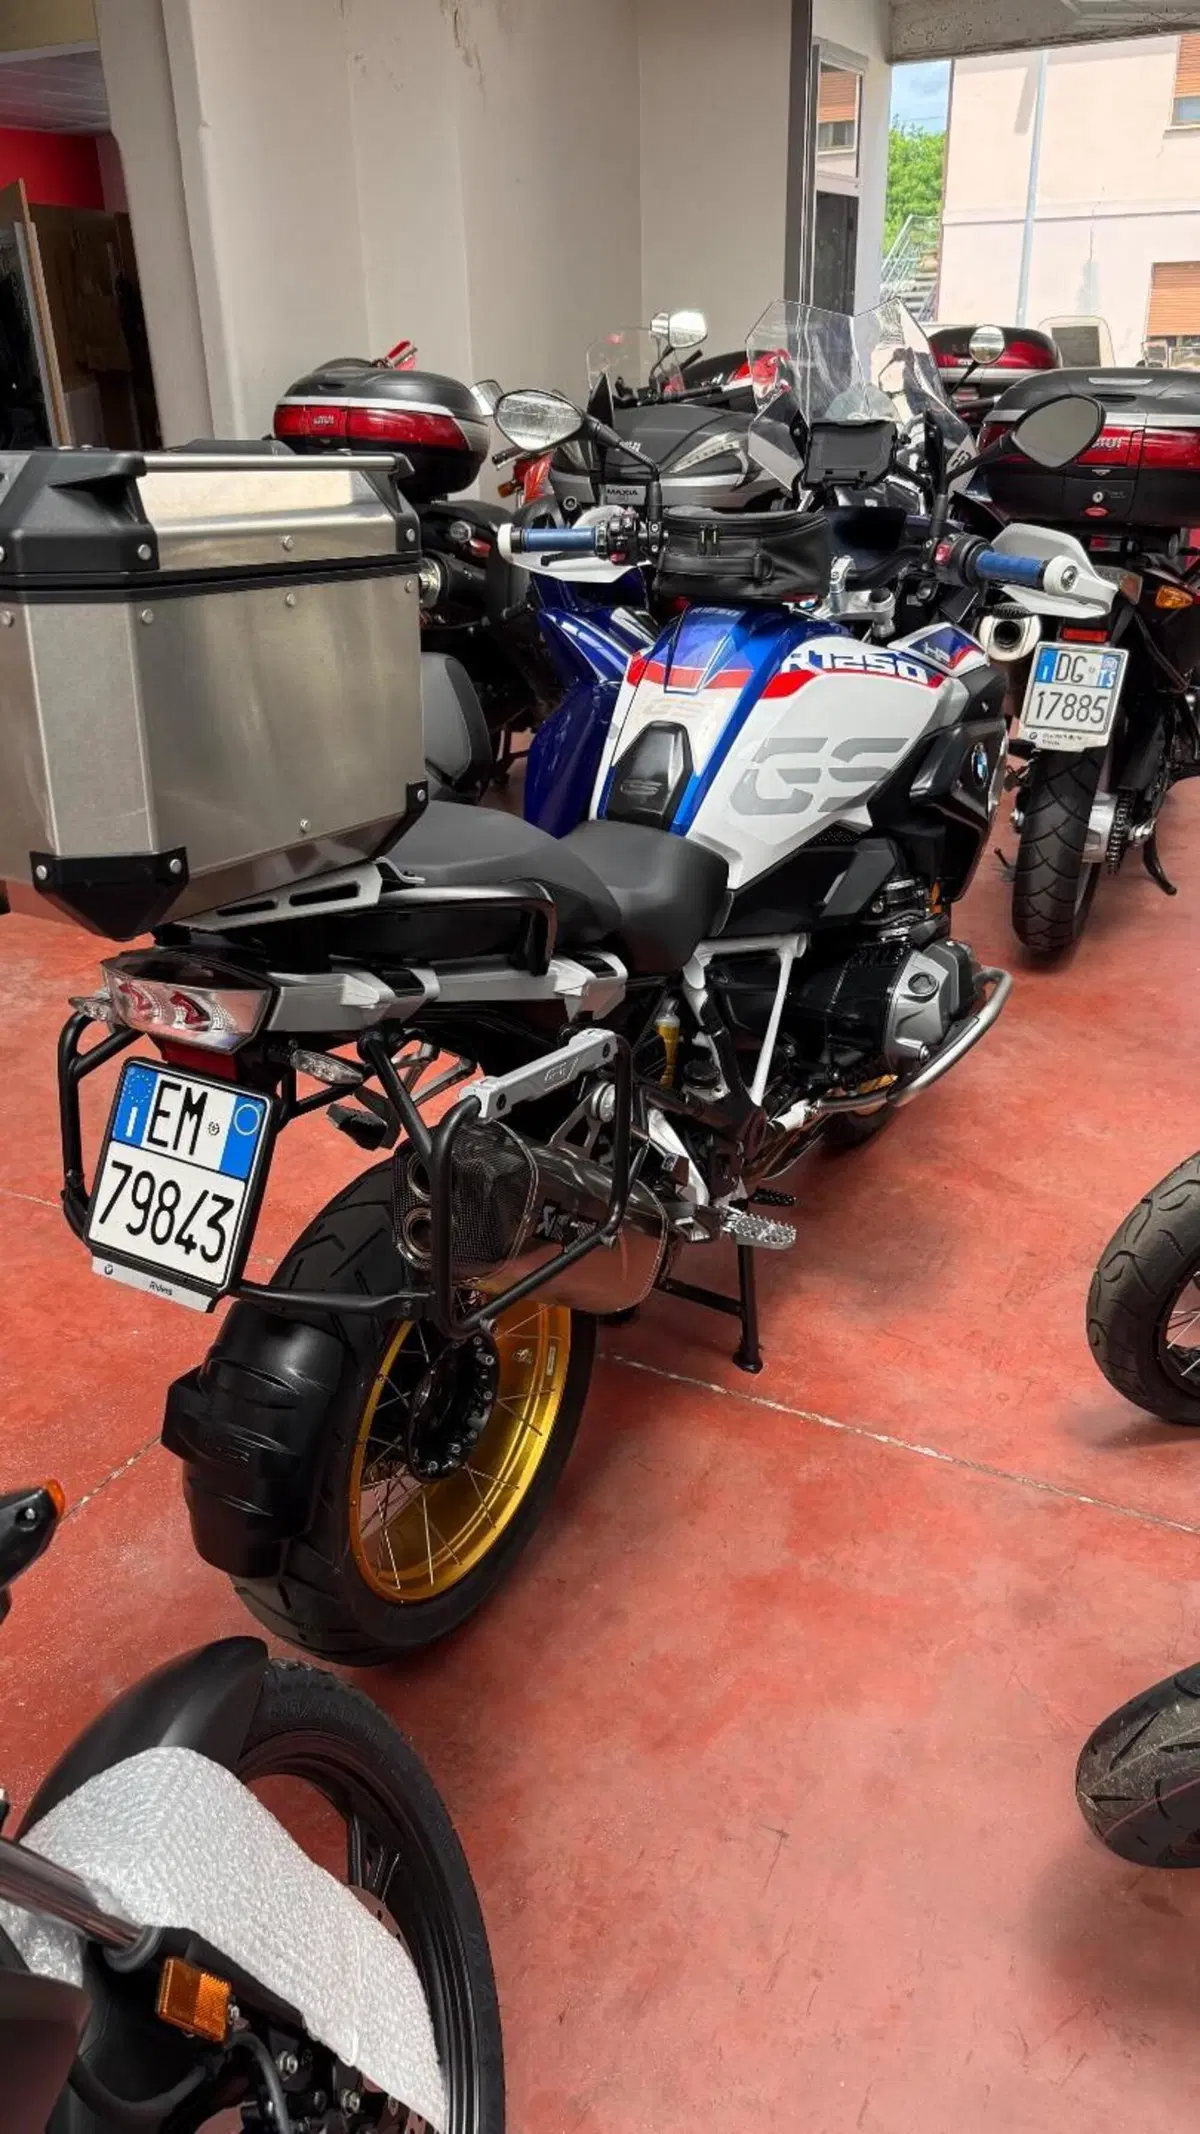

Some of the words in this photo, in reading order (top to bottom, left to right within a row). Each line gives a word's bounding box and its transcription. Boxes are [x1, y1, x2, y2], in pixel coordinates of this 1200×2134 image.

[780, 649, 929, 685] R1250
[1055, 653, 1088, 683] DG
[1035, 691, 1109, 724] 17885
[729, 737, 910, 816] GS
[146, 1079, 208, 1156] EM
[98, 1159, 236, 1264] 79843
